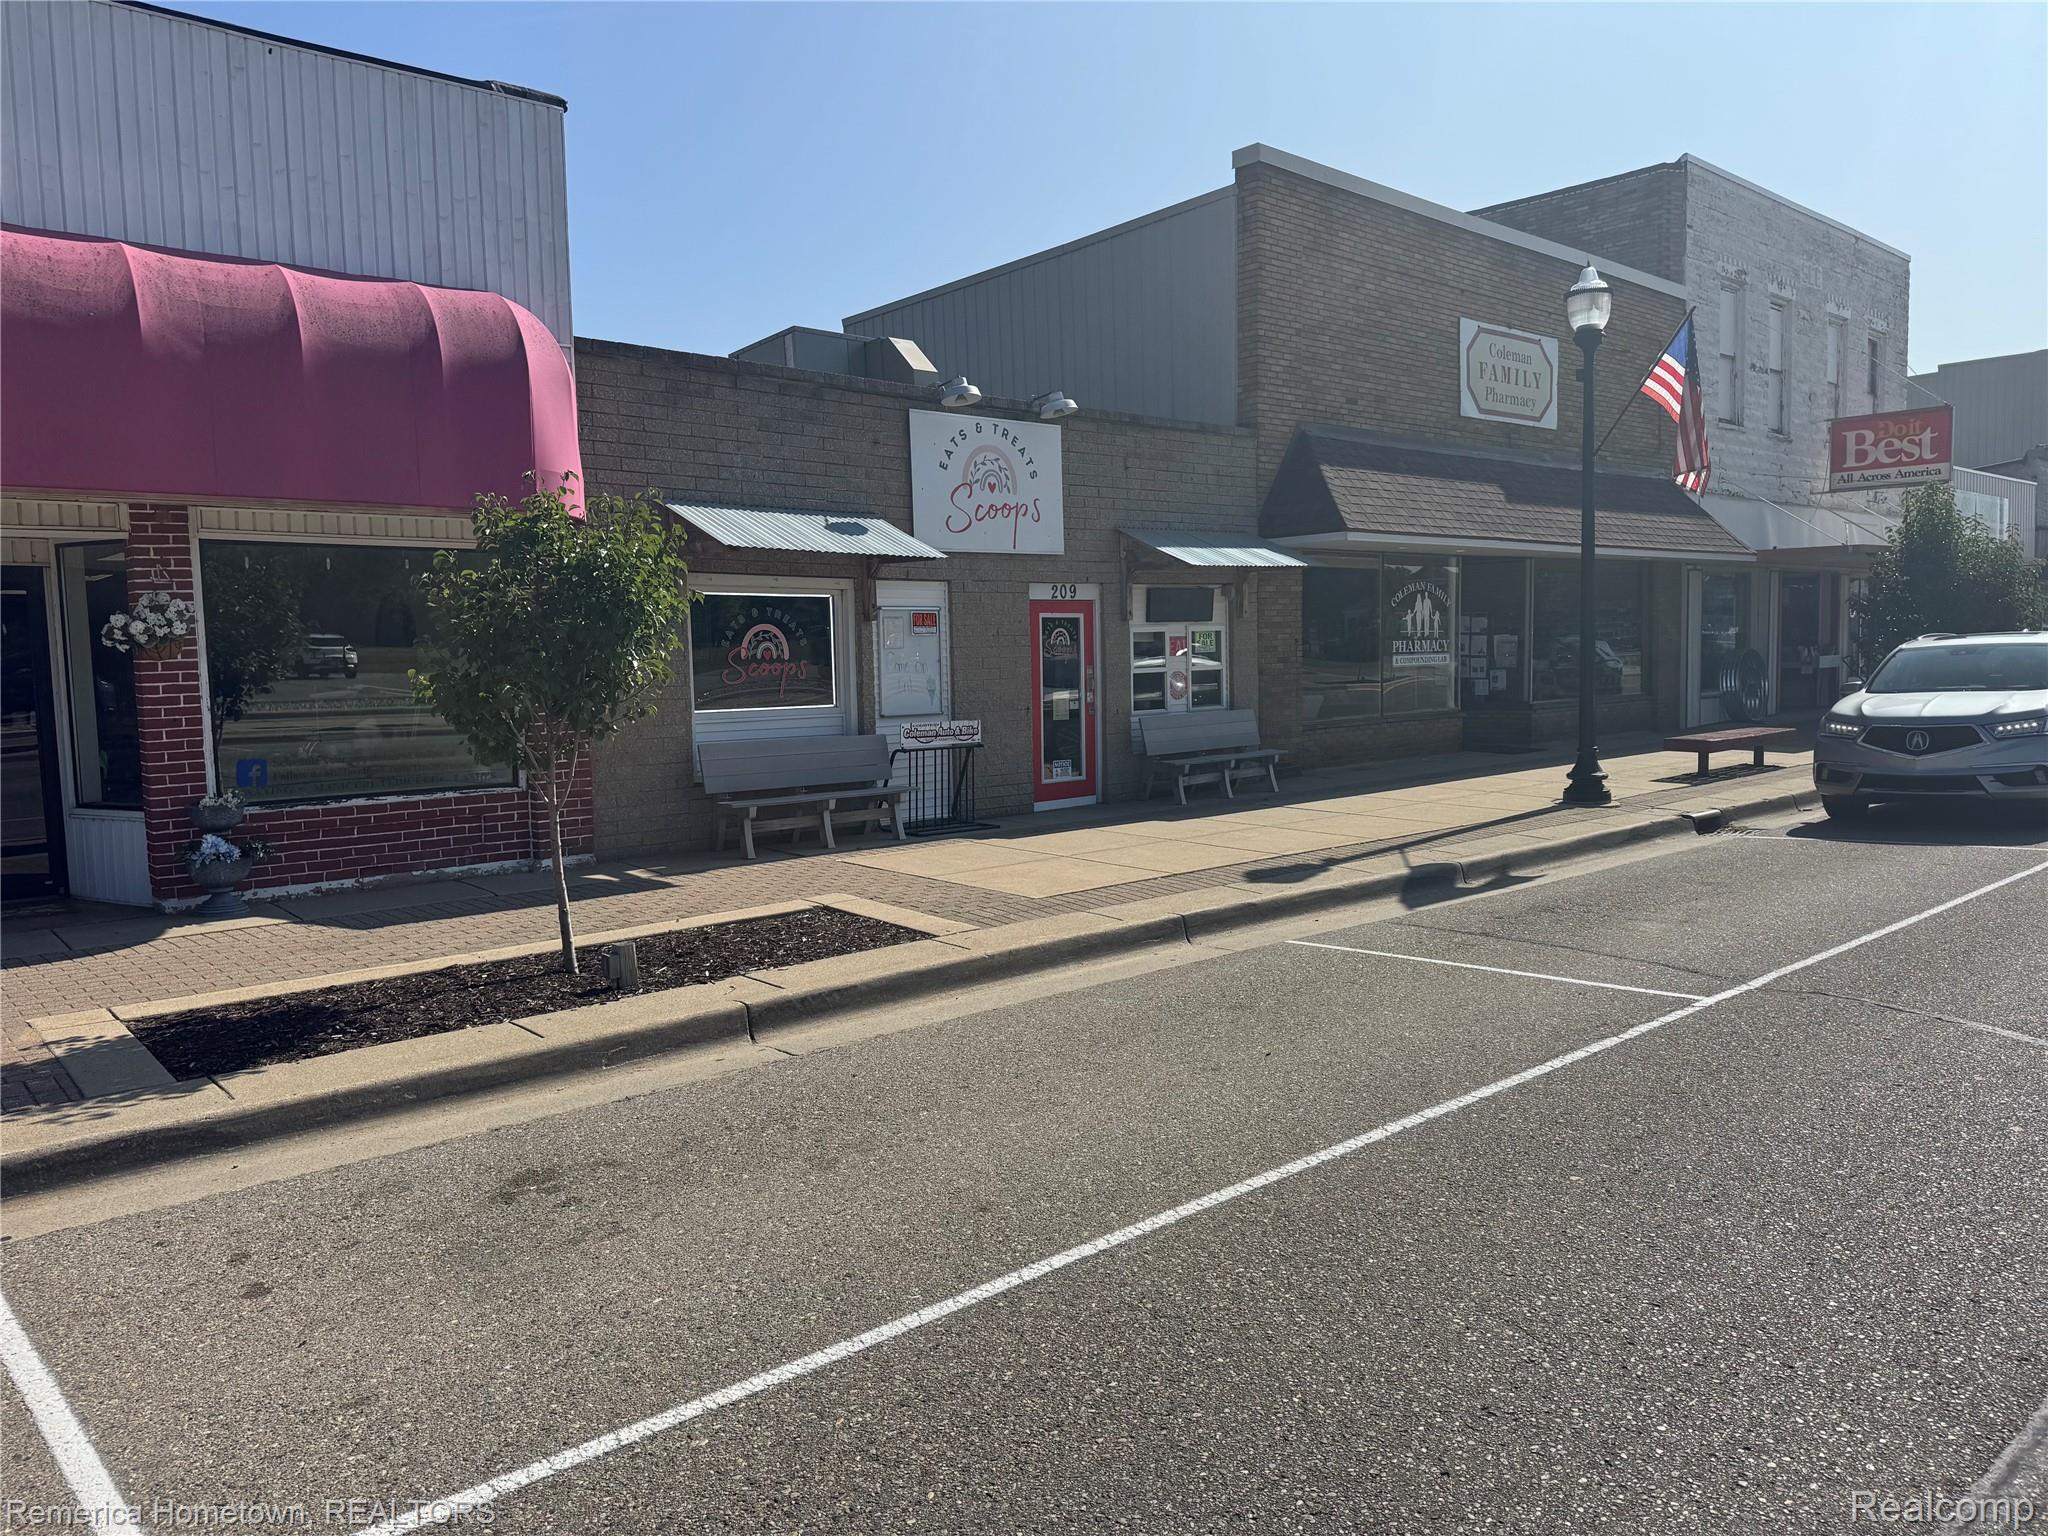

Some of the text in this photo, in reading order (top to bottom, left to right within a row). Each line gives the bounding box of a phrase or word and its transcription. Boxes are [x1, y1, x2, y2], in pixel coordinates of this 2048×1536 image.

[1489, 342, 1532, 365] Coleman
[1479, 361, 1542, 390] FAMILY
[1485, 386, 1537, 411] Pharmacy
[938, 422, 1038, 480] EATS & TREATS
[1841, 426, 1939, 468] Best
[1837, 466, 1942, 484] All Across America
[945, 482, 1041, 550] Scoops
[1051, 584, 1077, 599] 209
[1391, 581, 1451, 607] COLEMAN FAMILY
[914, 613, 937, 626] FOR SALE
[1199, 632, 1213, 640] FOR
[1392, 640, 1450, 653] PHARMACY
[722, 646, 808, 698] Scoops
[903, 725, 979, 739] Coleman Auto & Bike
